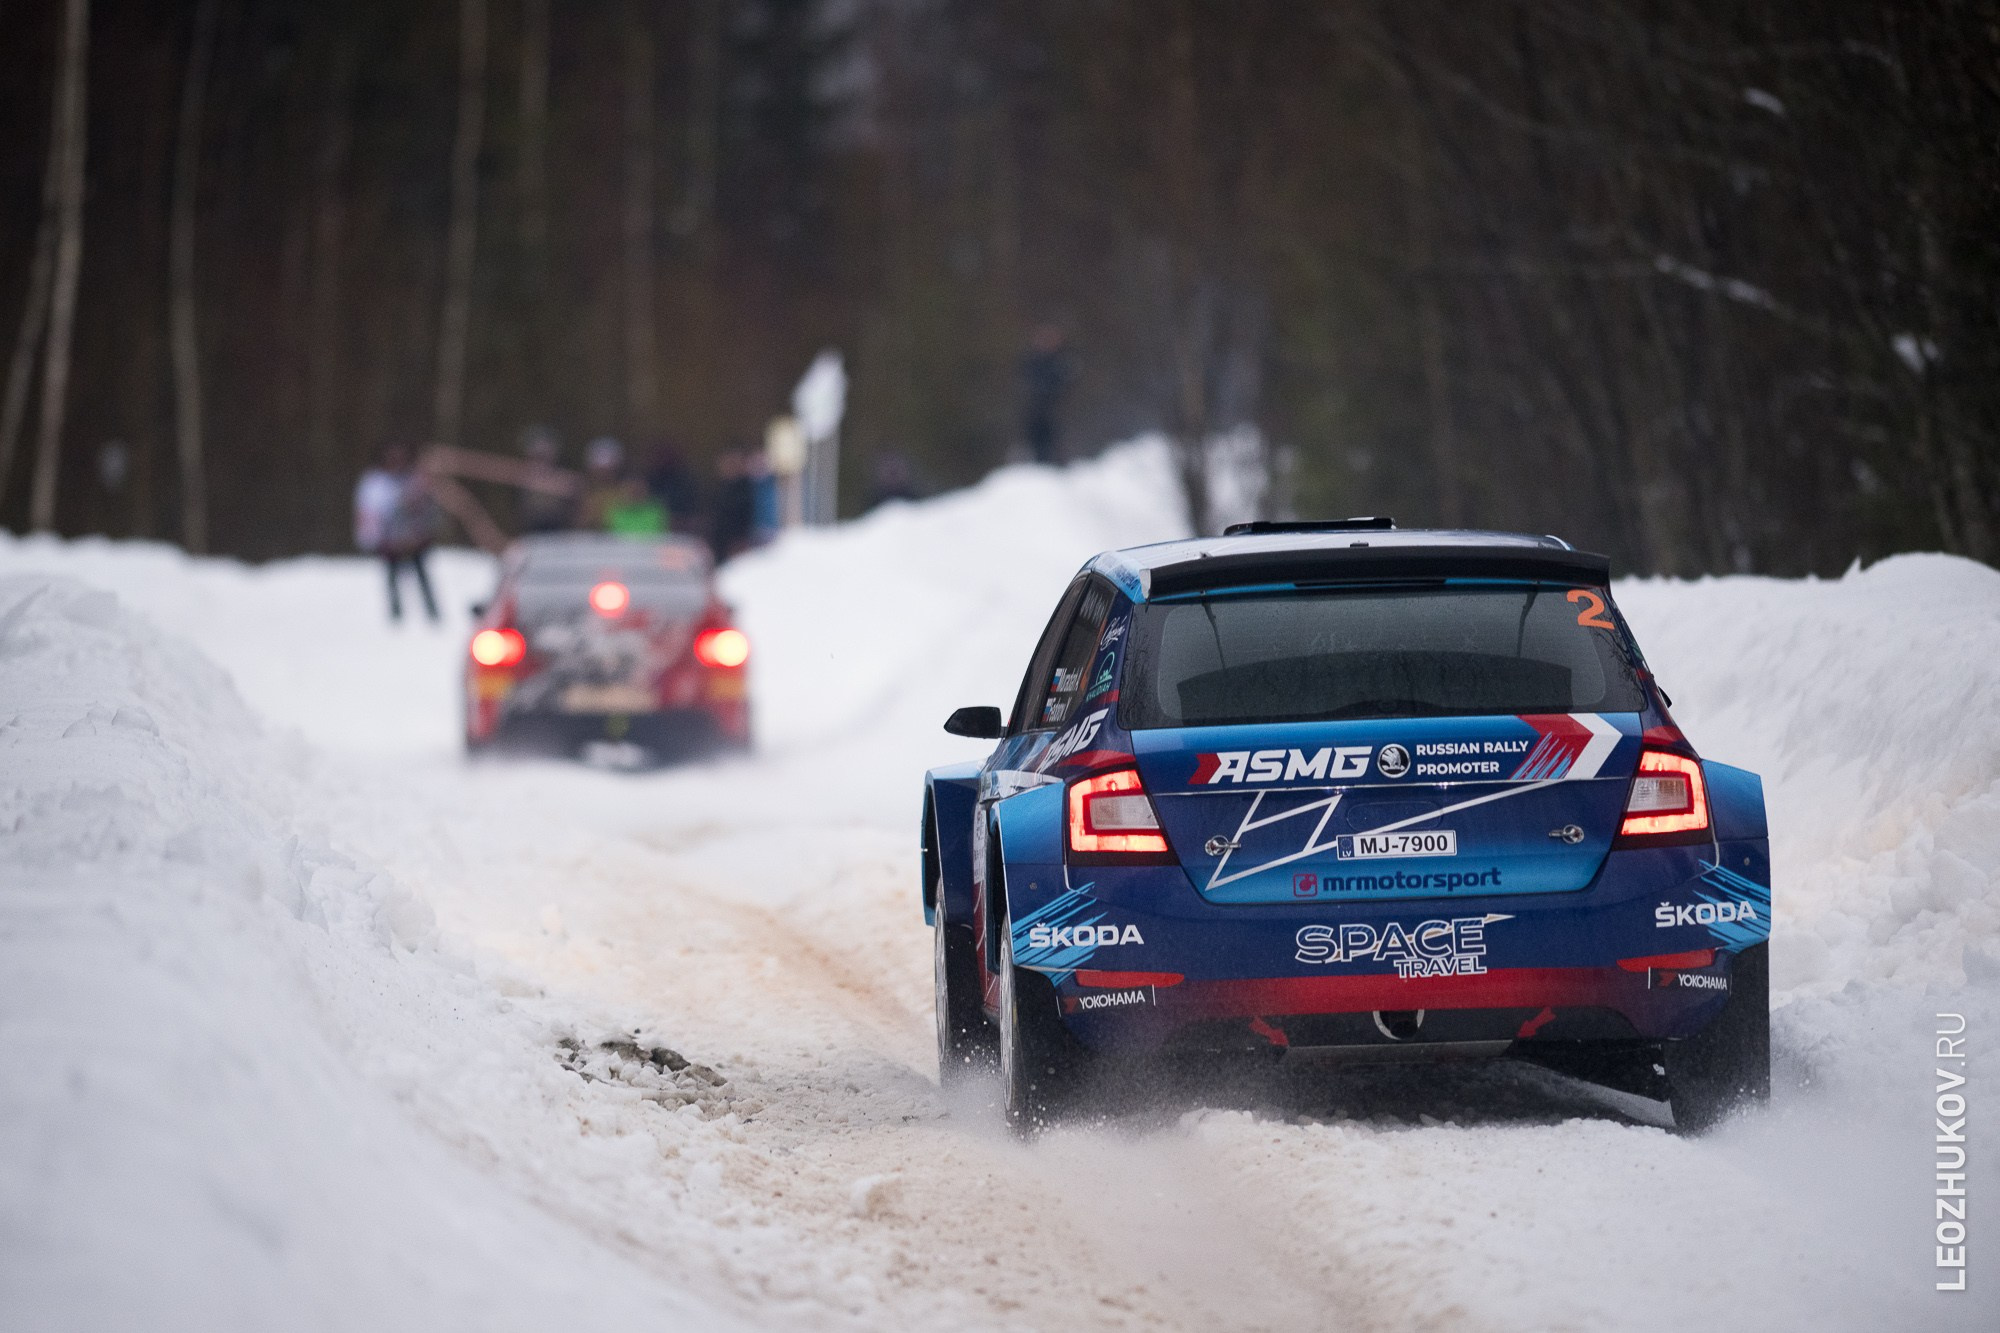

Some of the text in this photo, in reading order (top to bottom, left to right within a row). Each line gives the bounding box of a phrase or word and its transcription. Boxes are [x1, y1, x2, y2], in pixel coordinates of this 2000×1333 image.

[1566, 589, 1615, 630] 2
[1416, 740, 1529, 757] RUSSIAN RALLY
[1208, 745, 1373, 784] ASMG
[1416, 761, 1500, 776] PROMOTER
[1360, 835, 1449, 854] MJ-7900
[1323, 867, 1502, 892] mrmotorsport
[1655, 901, 1758, 928] ŠKODA
[1029, 922, 1145, 948] ŠKODA
[1295, 917, 1487, 964] SPACE
[1393, 955, 1488, 979] TRAVEL
[1678, 973, 1728, 991] YOKOHAMA
[1079, 990, 1146, 1010] YOKOHAMA
